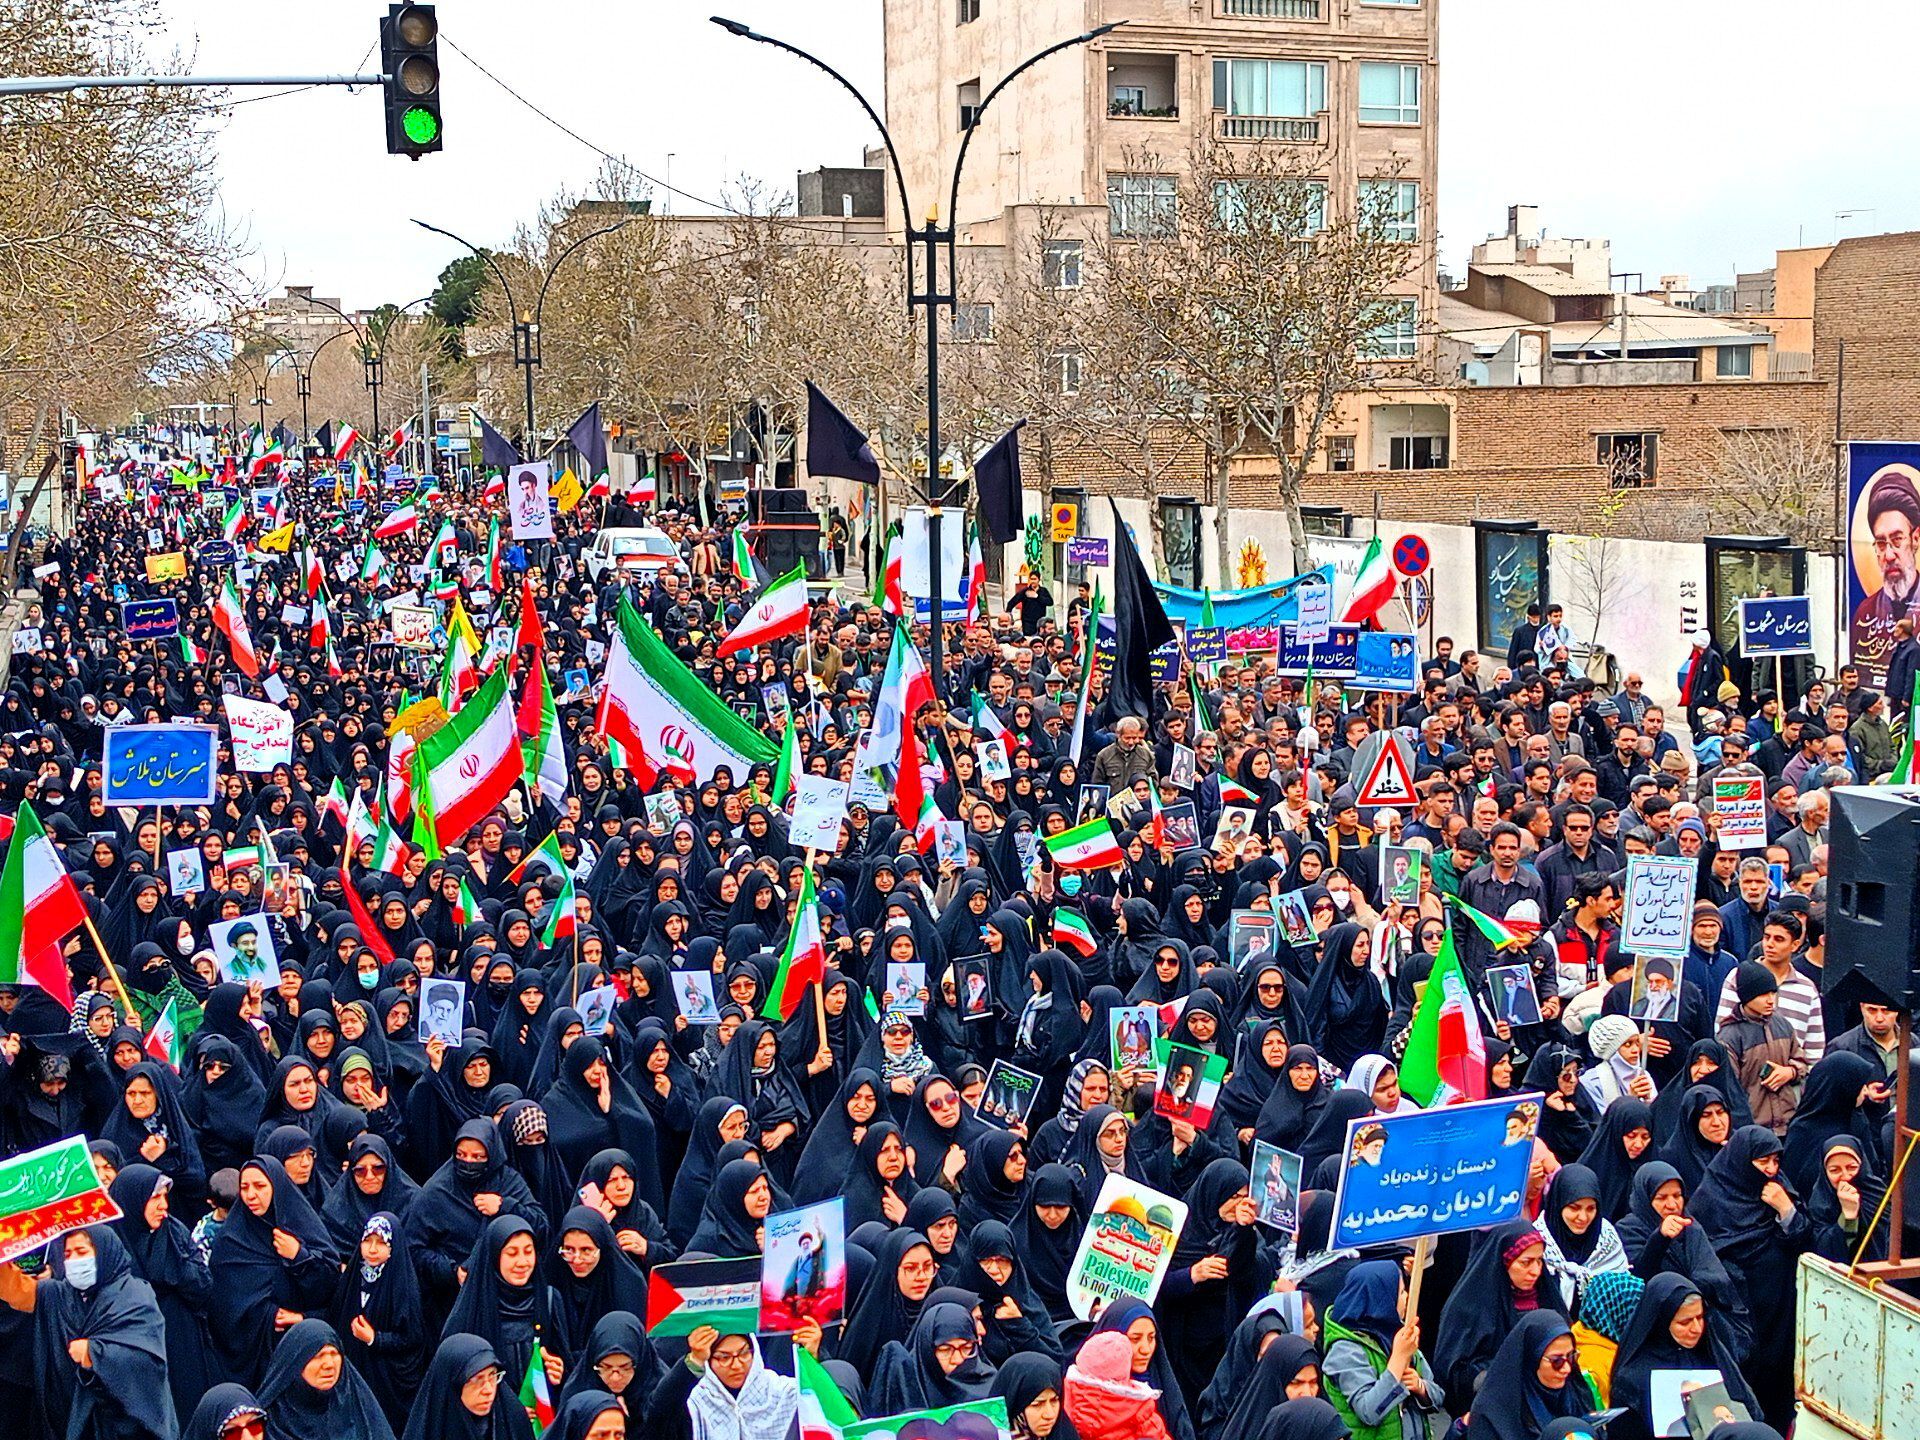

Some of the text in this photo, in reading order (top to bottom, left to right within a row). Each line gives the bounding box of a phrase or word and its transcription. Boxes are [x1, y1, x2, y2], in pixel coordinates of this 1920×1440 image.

[1775, 614, 1809, 635] دبیرستان
[112, 749, 207, 787] هنرستان تلاش
[1372, 782, 1403, 797] خطر
[1442, 1157, 1497, 1182] دبستان
[66, 1198, 107, 1214] مرگ
[1341, 1184, 1520, 1234] مرادیان محمدیه
[3, 1232, 44, 1256] DOWN
[43, 1220, 75, 1238] WITH
[1096, 1222, 1164, 1257] فلسطین
[1091, 1239, 1157, 1274] تنها نیست
[1079, 1272, 1090, 1288] is
[1090, 1277, 1111, 1297] not
[1084, 1254, 1149, 1296] Palestine
